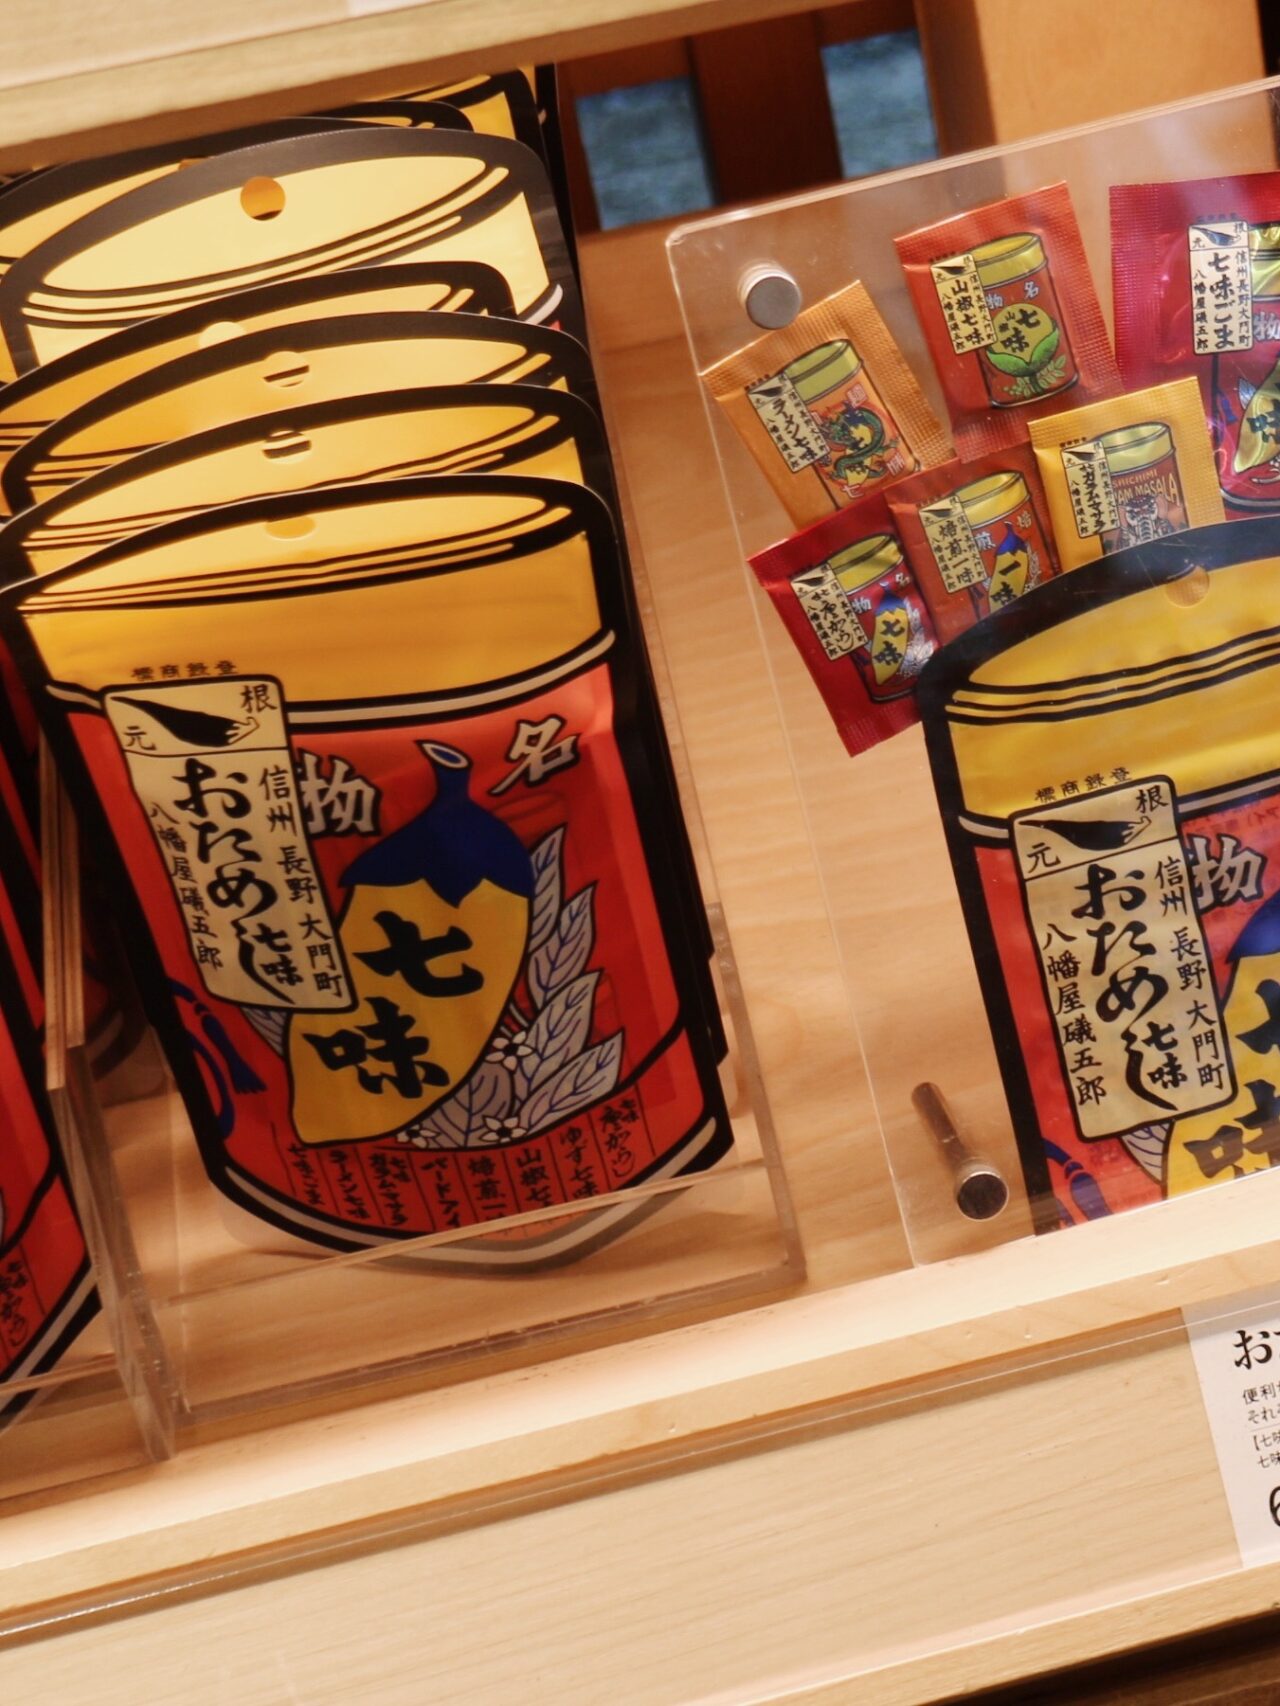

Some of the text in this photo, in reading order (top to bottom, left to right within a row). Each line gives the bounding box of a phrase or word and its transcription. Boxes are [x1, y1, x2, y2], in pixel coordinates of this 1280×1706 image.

[951, 279, 985, 345] 山椒七味
[1024, 281, 1039, 299] 名
[1208, 252, 1236, 350] 七味ごま
[1000, 308, 1041, 353] 七味
[873, 619, 906, 666] 七味
[240, 684, 277, 713] 根
[124, 725, 157, 750] 元
[488, 714, 580, 796] 名
[296, 747, 382, 837] 物
[1135, 784, 1169, 814] 根
[1026, 842, 1061, 873] 元
[1186, 833, 1267, 912] 物
[303, 910, 487, 1100] 七味
[467, 1156, 508, 1219] 焙煎一
[515, 1149, 552, 1208] 山椒七
